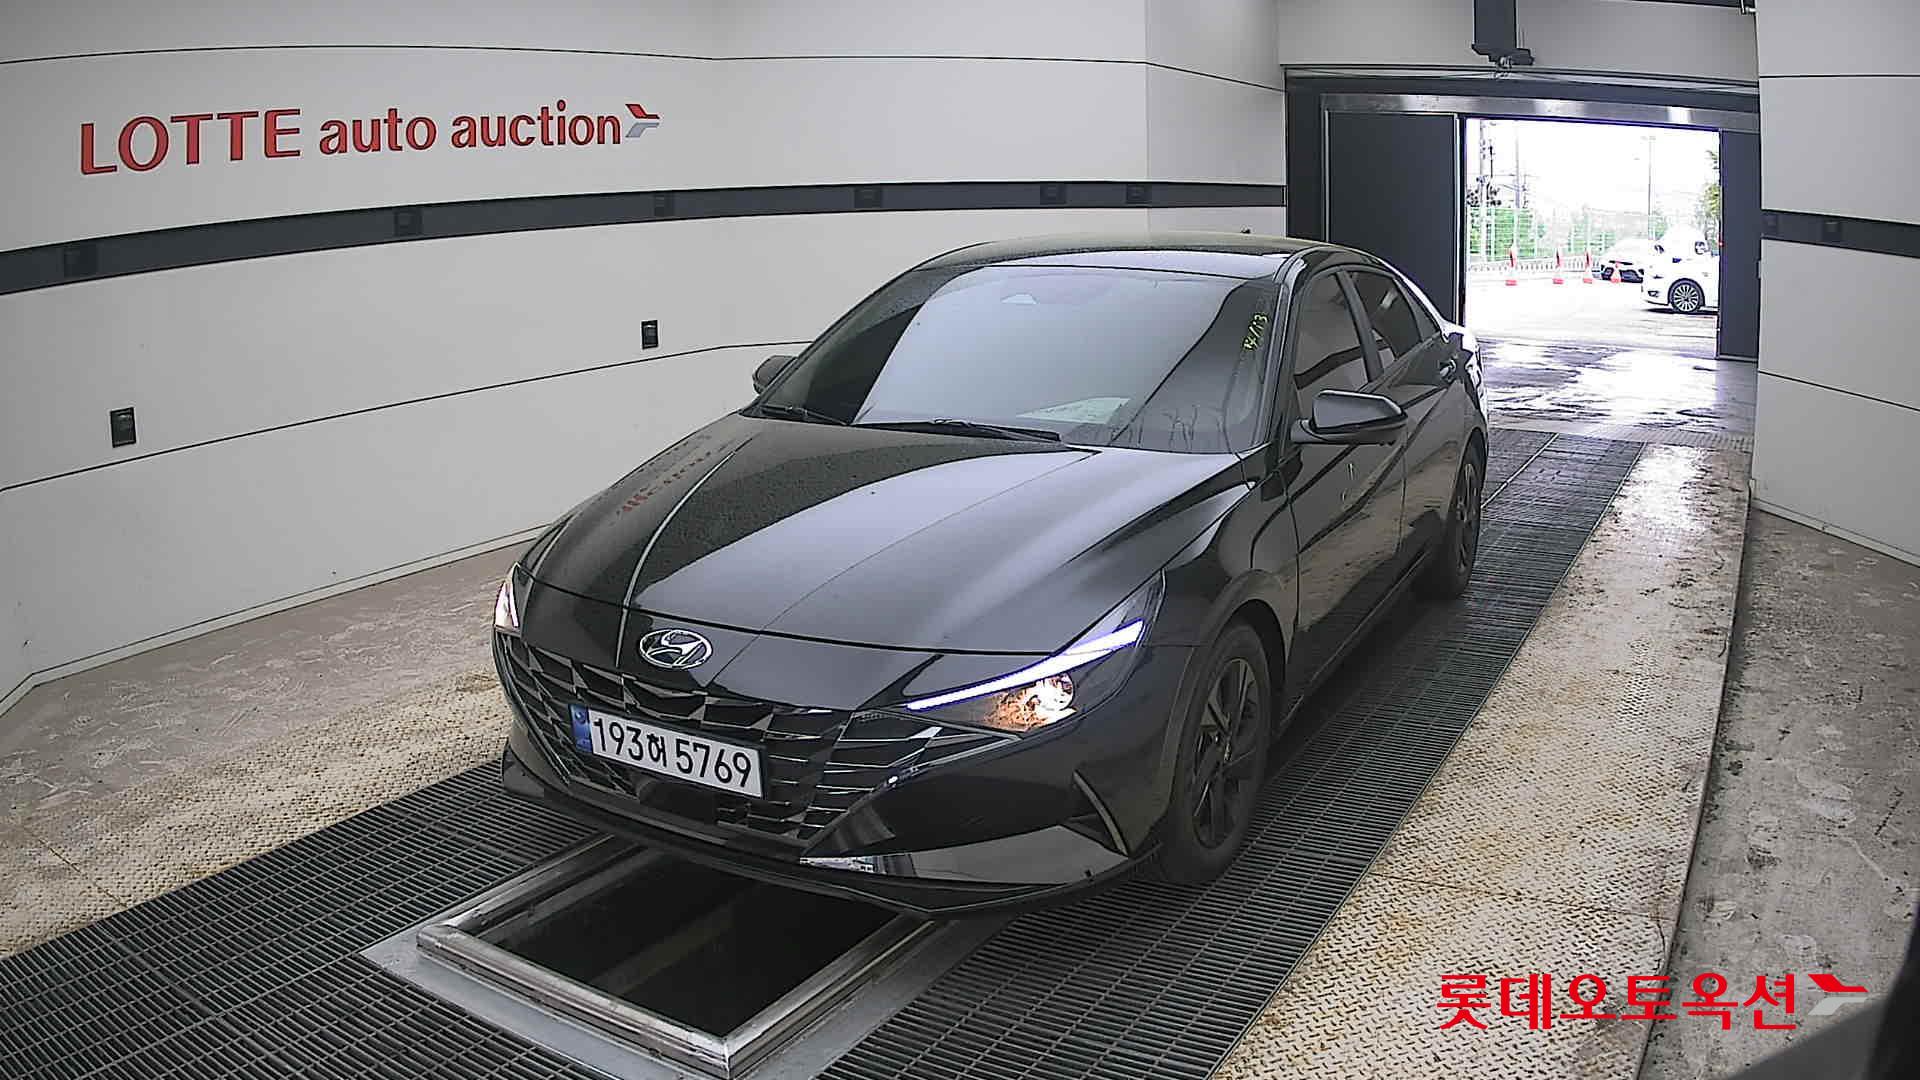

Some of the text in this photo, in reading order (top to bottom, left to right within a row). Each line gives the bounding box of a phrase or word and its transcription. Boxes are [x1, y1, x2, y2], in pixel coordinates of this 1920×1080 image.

[80, 99, 622, 175] LOTTE auto auction
[593, 717, 752, 788] 193허 5769
